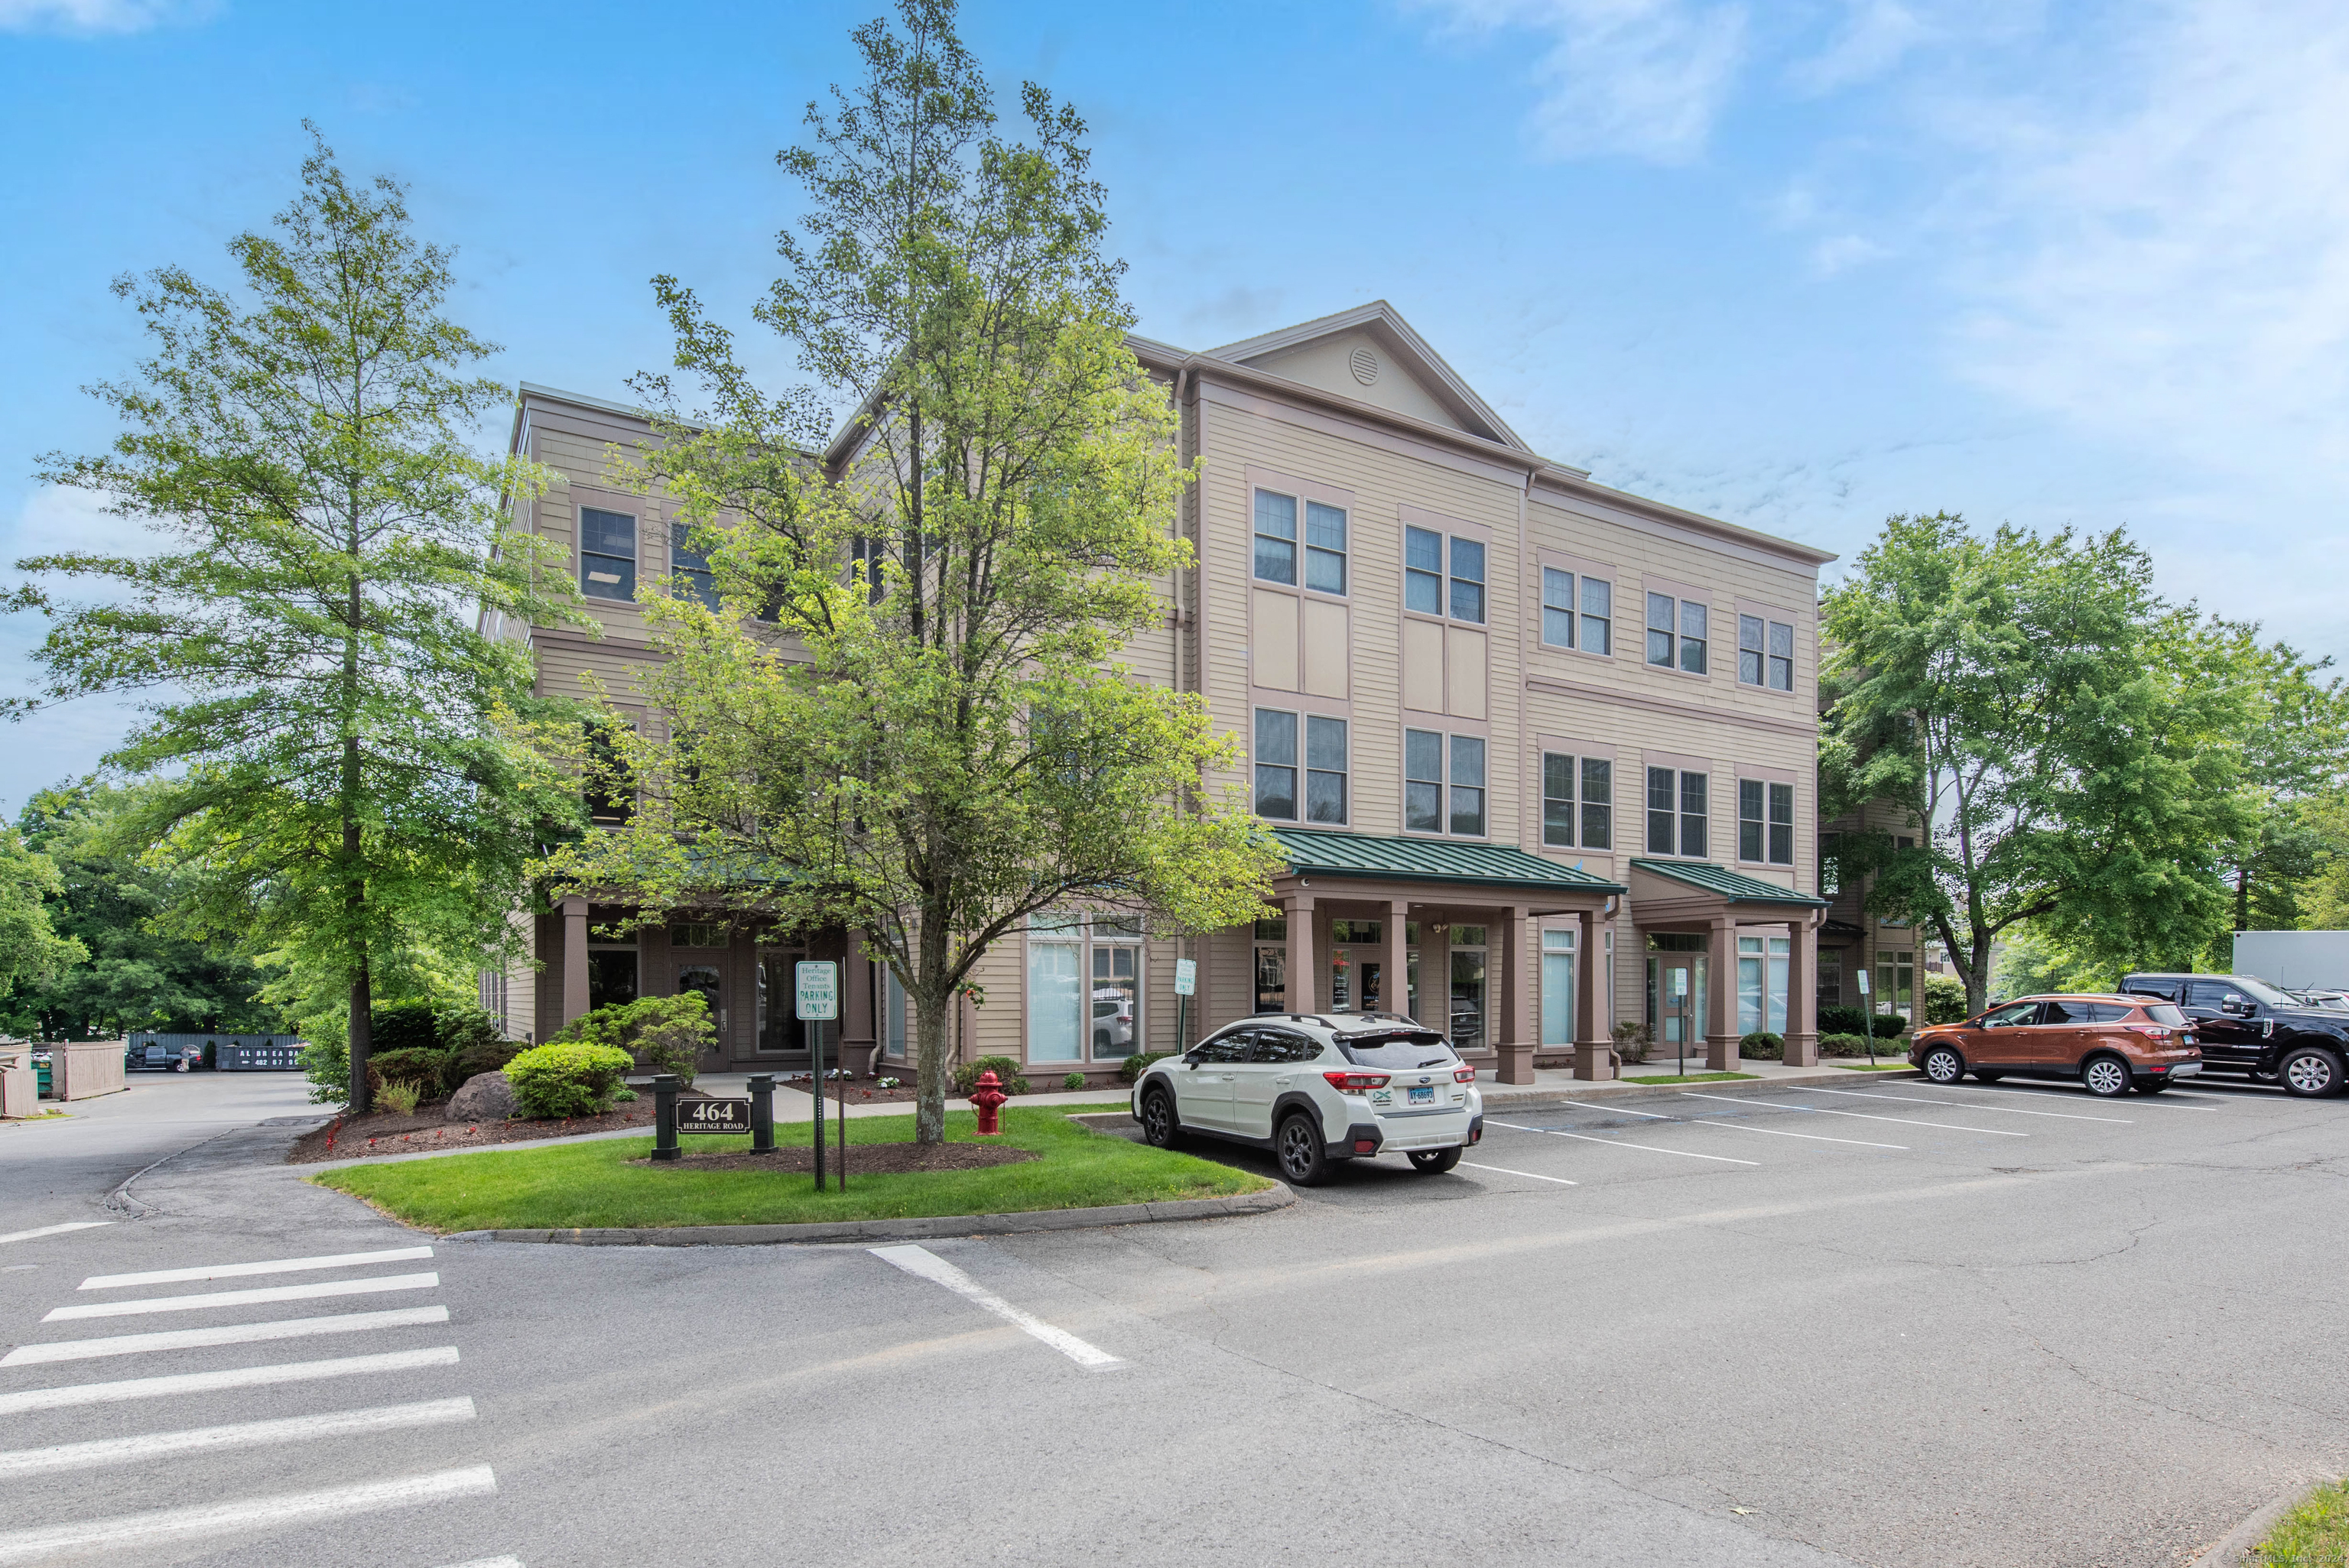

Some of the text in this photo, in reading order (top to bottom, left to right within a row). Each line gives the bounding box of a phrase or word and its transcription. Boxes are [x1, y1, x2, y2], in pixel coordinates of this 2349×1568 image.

[800, 991, 833, 1001] PARKING
[806, 1003, 827, 1014] ONLY
[693, 1102, 734, 1121] 464
